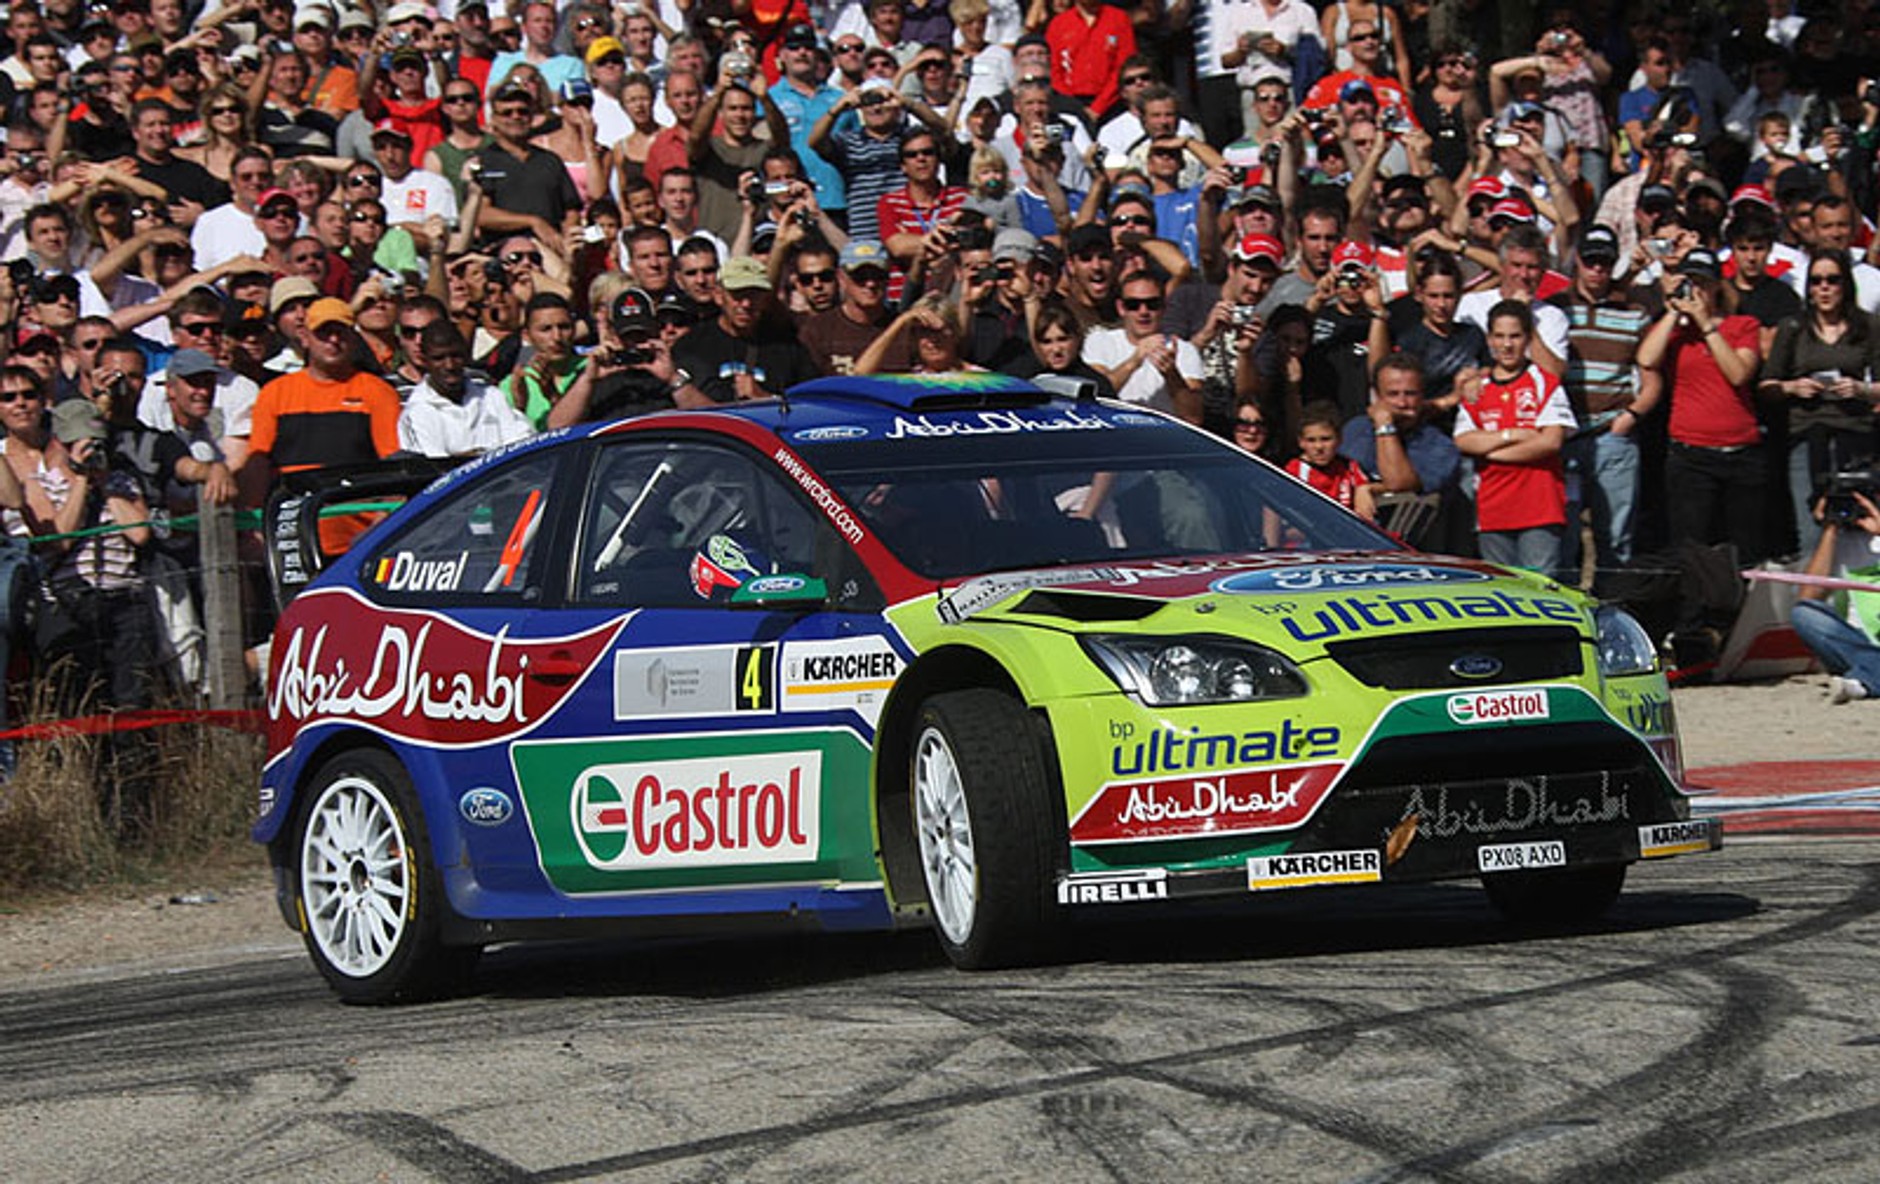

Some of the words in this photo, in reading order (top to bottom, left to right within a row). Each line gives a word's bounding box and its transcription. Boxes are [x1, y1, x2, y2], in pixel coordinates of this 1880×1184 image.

[388, 550, 469, 591] Duval
[1272, 567, 1450, 588] Ford
[1280, 591, 1582, 642] ultimate
[741, 647, 763, 711] 4
[802, 652, 897, 682] KÄRCHER
[1475, 693, 1544, 719] Castrol
[1109, 719, 1135, 739] bp
[1113, 719, 1341, 776] ultimate
[467, 795, 506, 819] Ford
[632, 766, 808, 857] Castrol
[1268, 852, 1379, 877] KÄRCHER
[1481, 846, 1525, 869] PX08
[1057, 868, 1167, 904] PIRELLI
